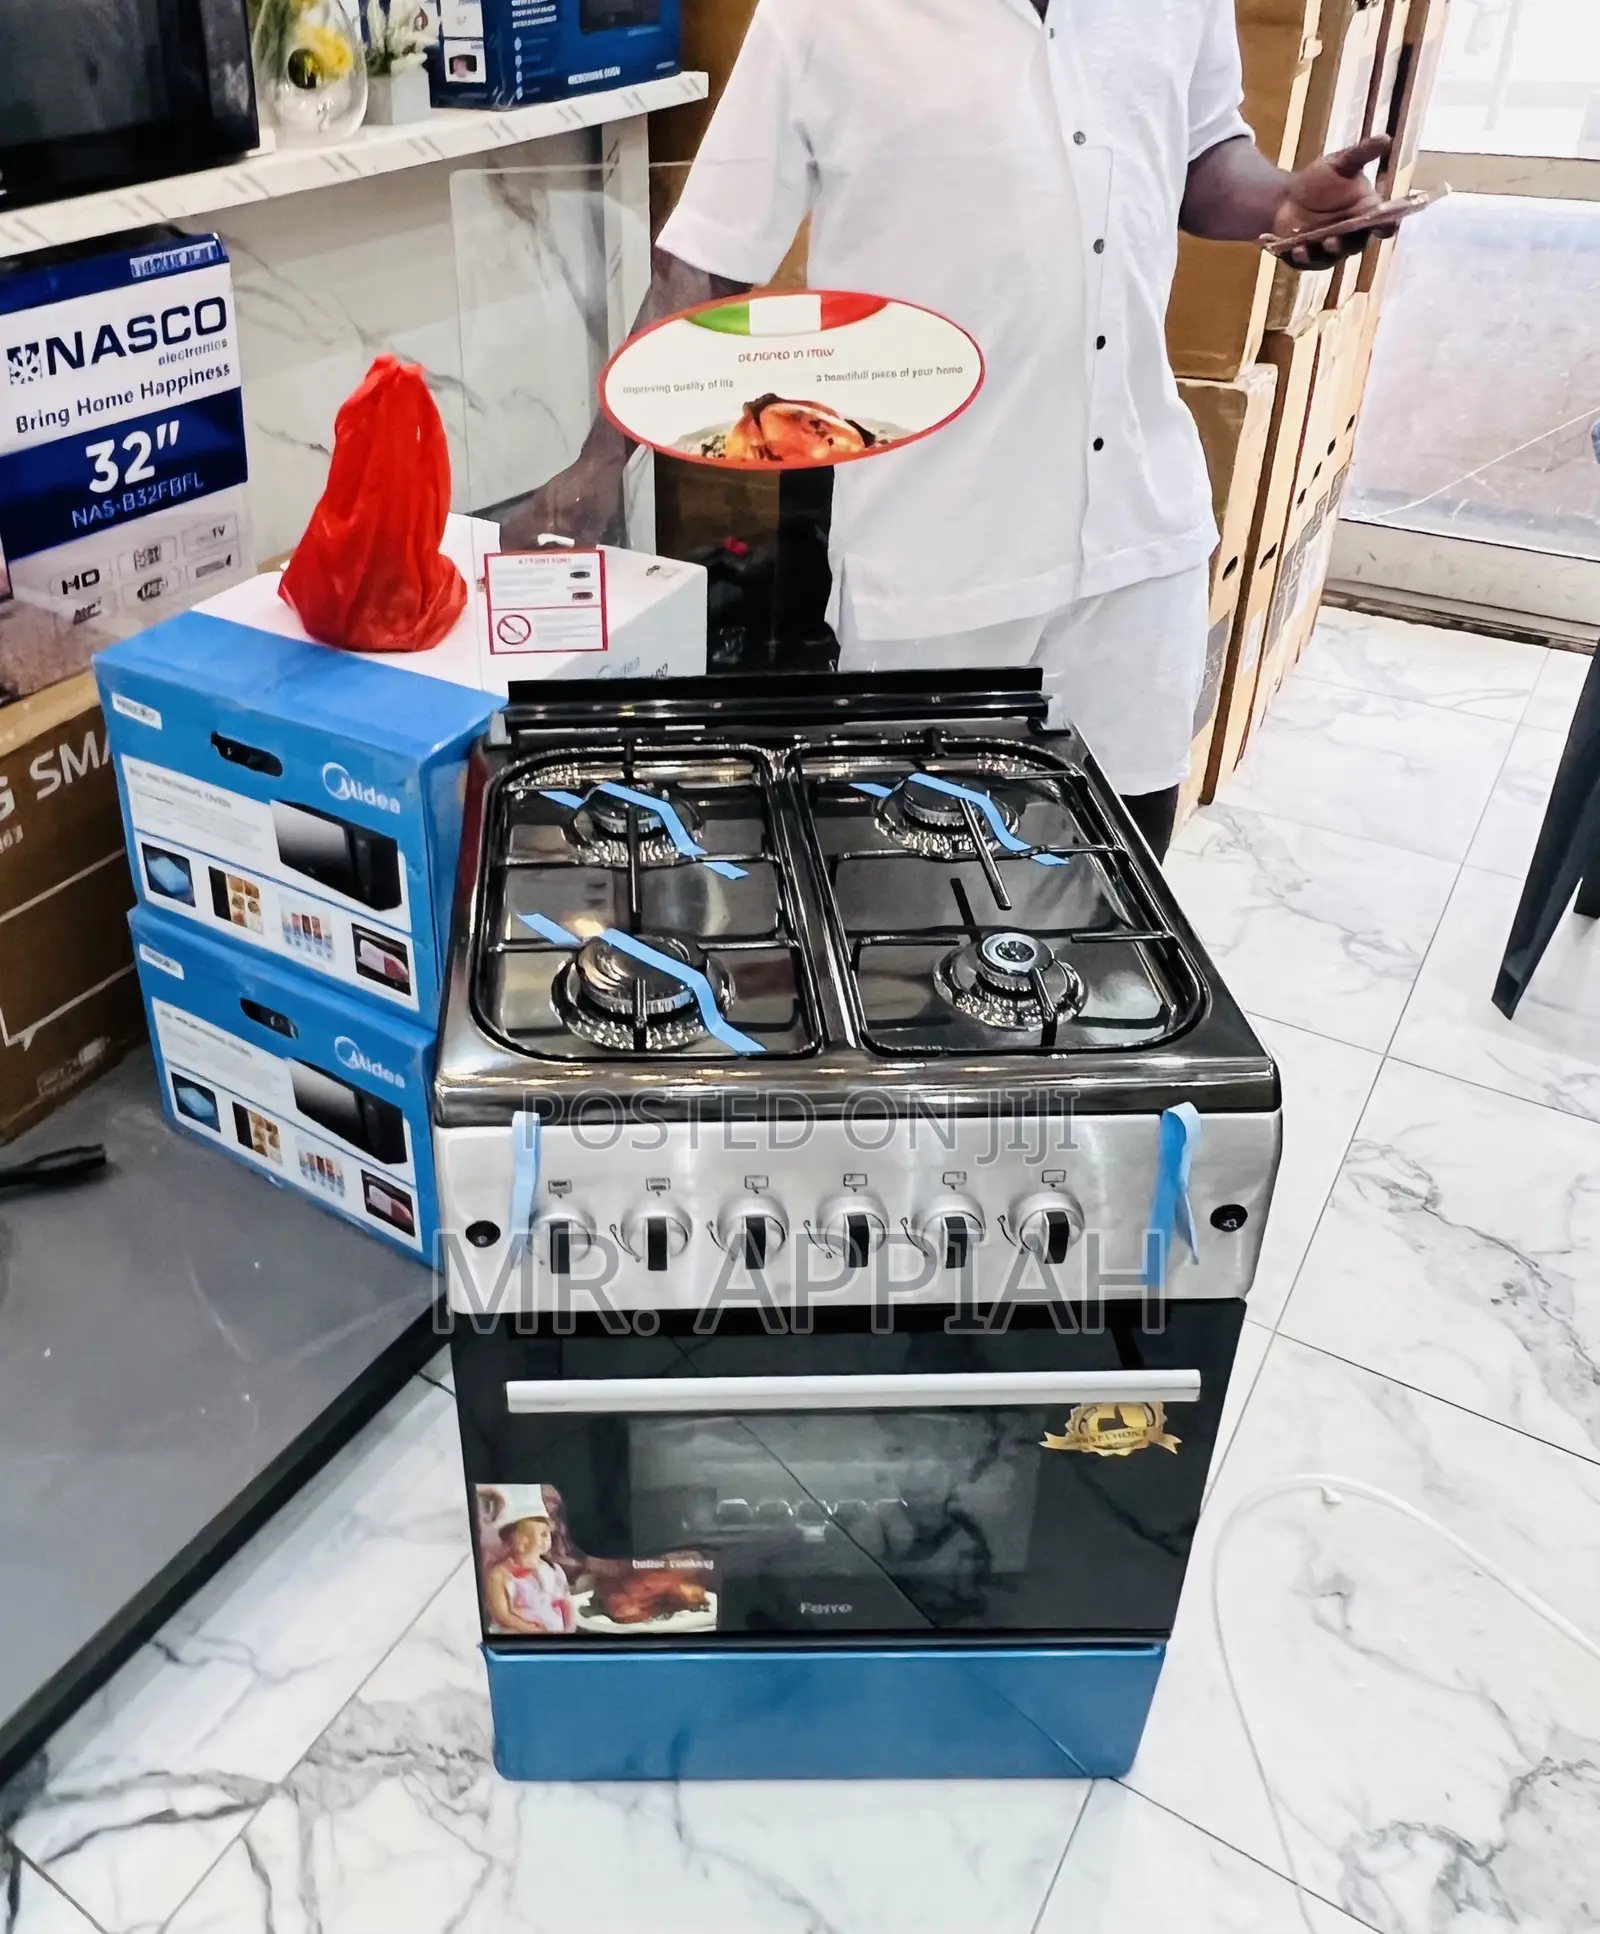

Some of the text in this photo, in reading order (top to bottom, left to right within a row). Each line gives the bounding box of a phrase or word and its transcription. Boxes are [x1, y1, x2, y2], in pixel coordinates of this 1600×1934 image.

[46, 297, 227, 376] NASCO
[158, 338, 228, 366] electronics
[673, 380, 705, 393] quality
[707, 378, 718, 390] of
[719, 377, 734, 389] life
[871, 370, 898, 381] piece
[899, 367, 910, 378] of
[912, 367, 934, 379] your
[936, 365, 964, 375] home
[16, 363, 231, 434] Bring Home Happiness
[212, 524, 226, 538] TV
[62, 568, 100, 595] HD
[322, 761, 401, 815] Midea
[334, 1034, 406, 1090] Midea
